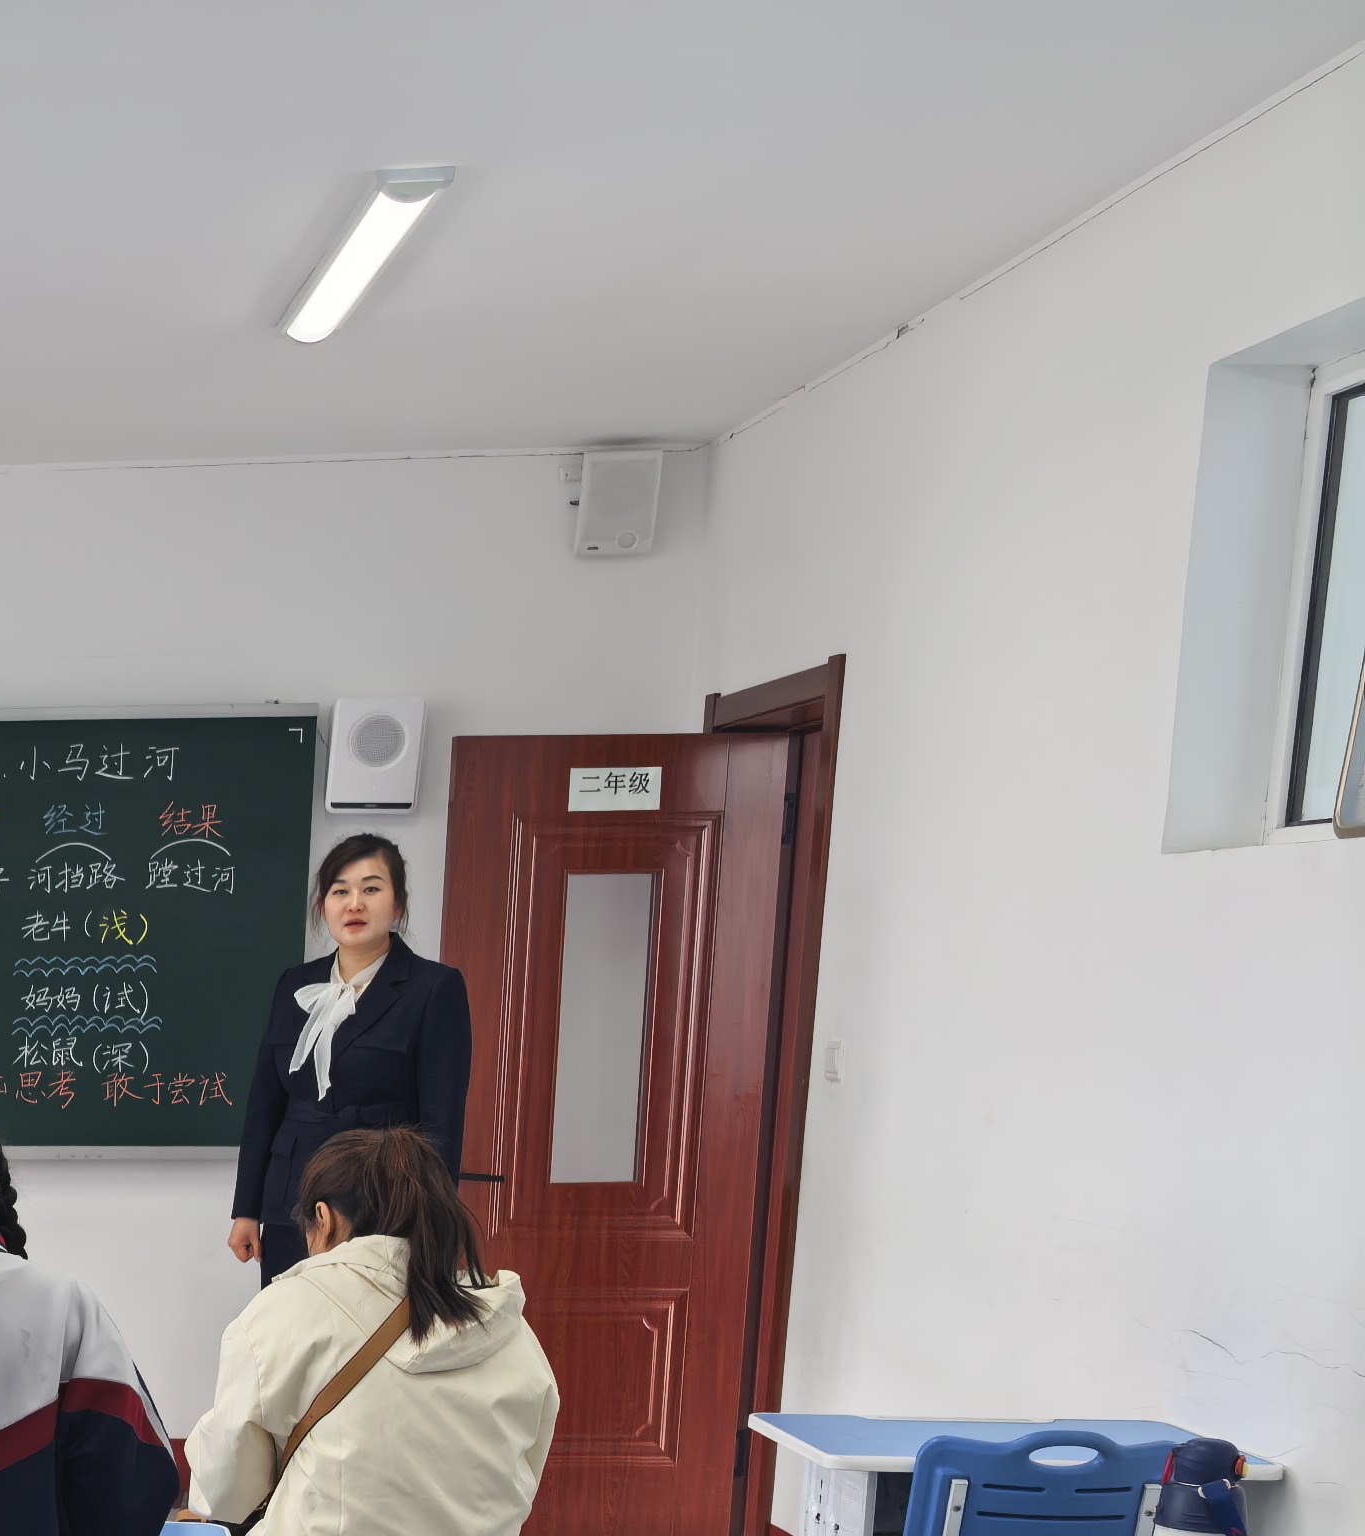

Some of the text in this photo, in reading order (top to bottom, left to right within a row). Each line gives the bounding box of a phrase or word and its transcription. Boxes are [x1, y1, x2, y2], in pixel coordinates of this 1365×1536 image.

[578, 770, 651, 796] 二年级
[43, 803, 108, 836] 经过
[159, 801, 225, 838] 结果
[28, 862, 126, 894] 河挡路
[102, 1071, 232, 1107] 敢于尝试
